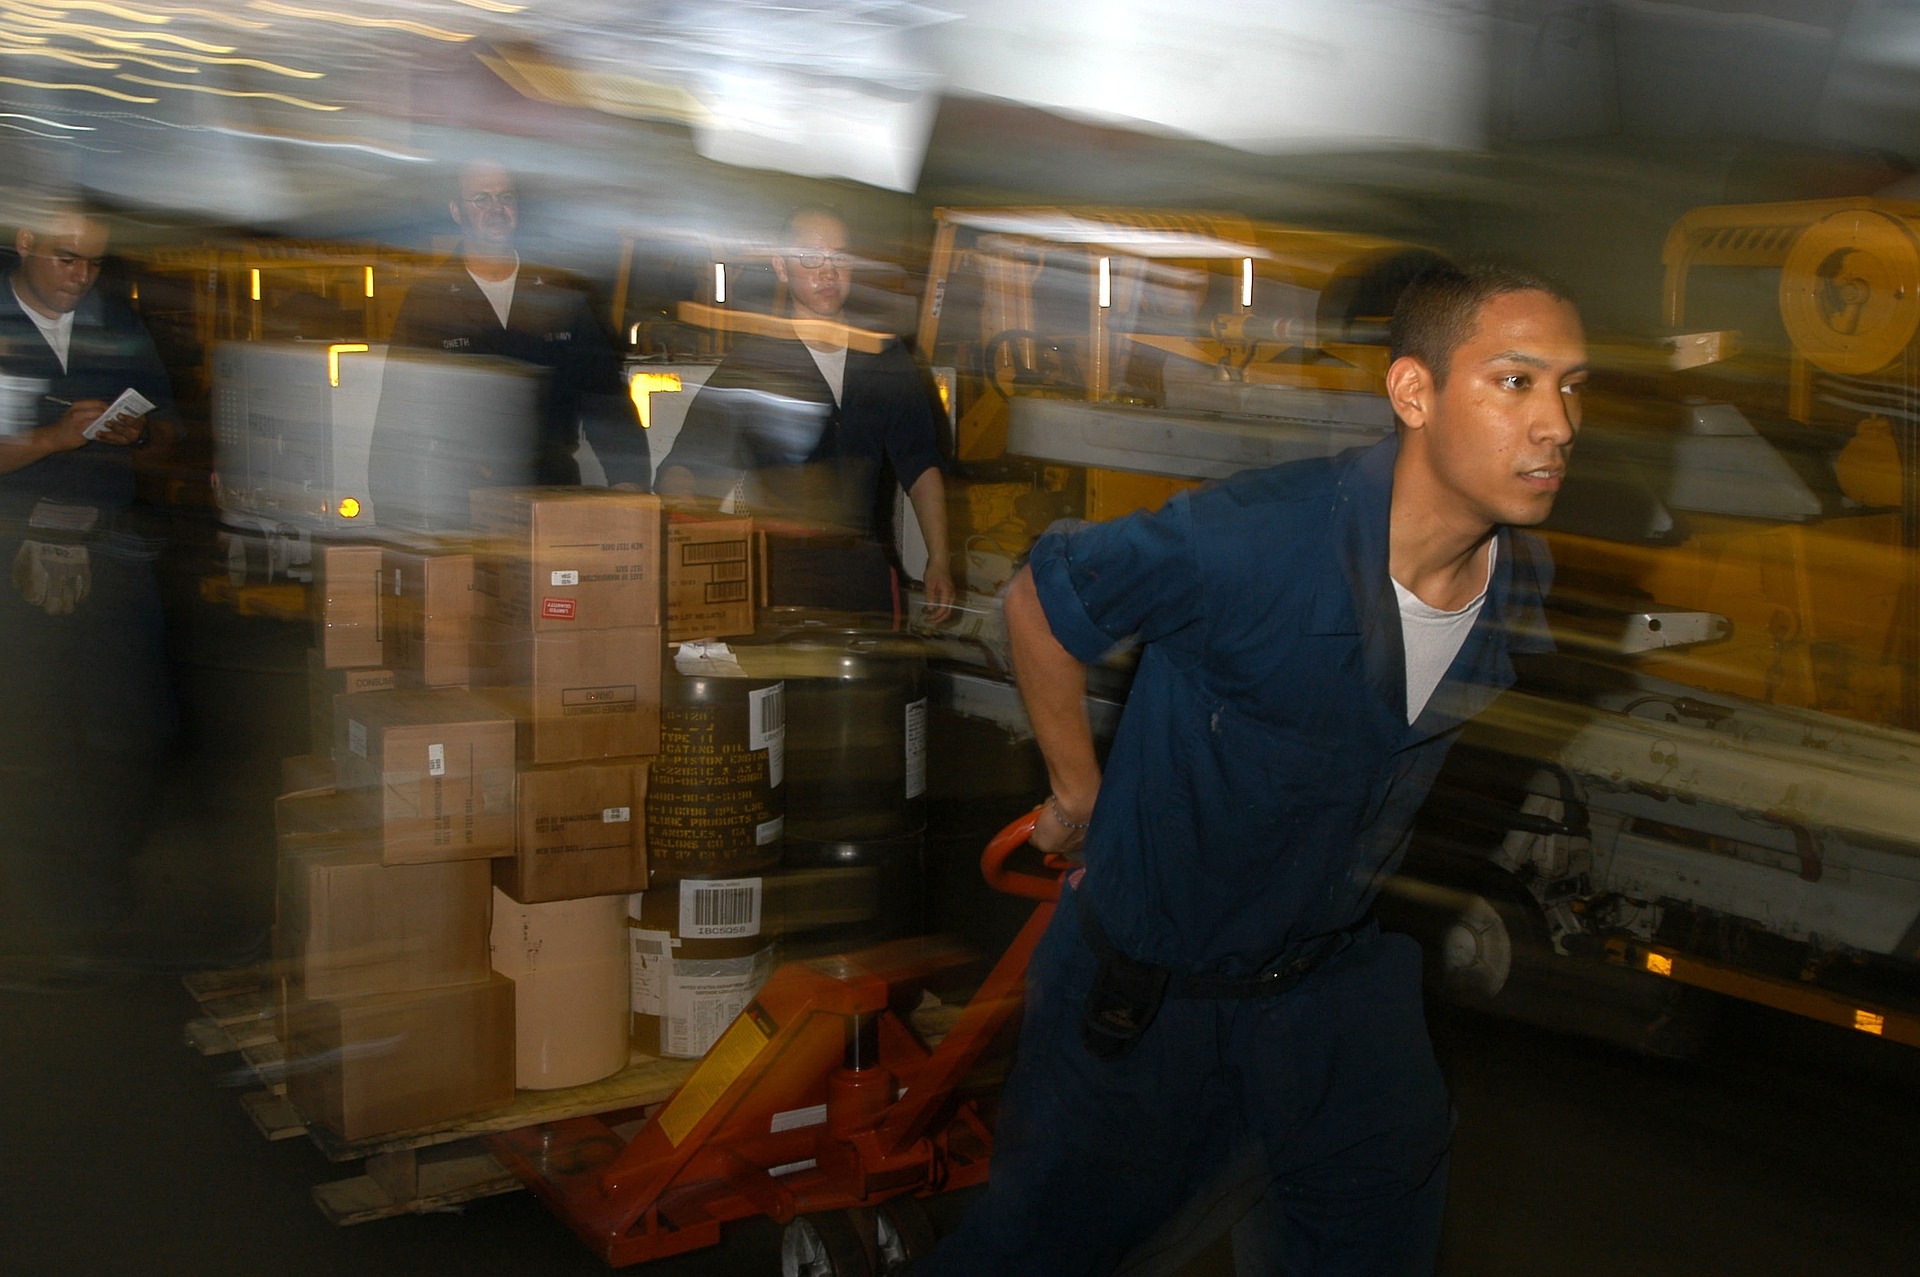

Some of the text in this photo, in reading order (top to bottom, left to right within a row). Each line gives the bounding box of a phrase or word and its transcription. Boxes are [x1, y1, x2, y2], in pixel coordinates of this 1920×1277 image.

[601, 543, 615, 551] DATE
[662, 733, 690, 743] TYPE
[722, 744, 744, 753] OIL
[674, 756, 723, 765] PISTON
[691, 815, 751, 827] PRODUCTS
